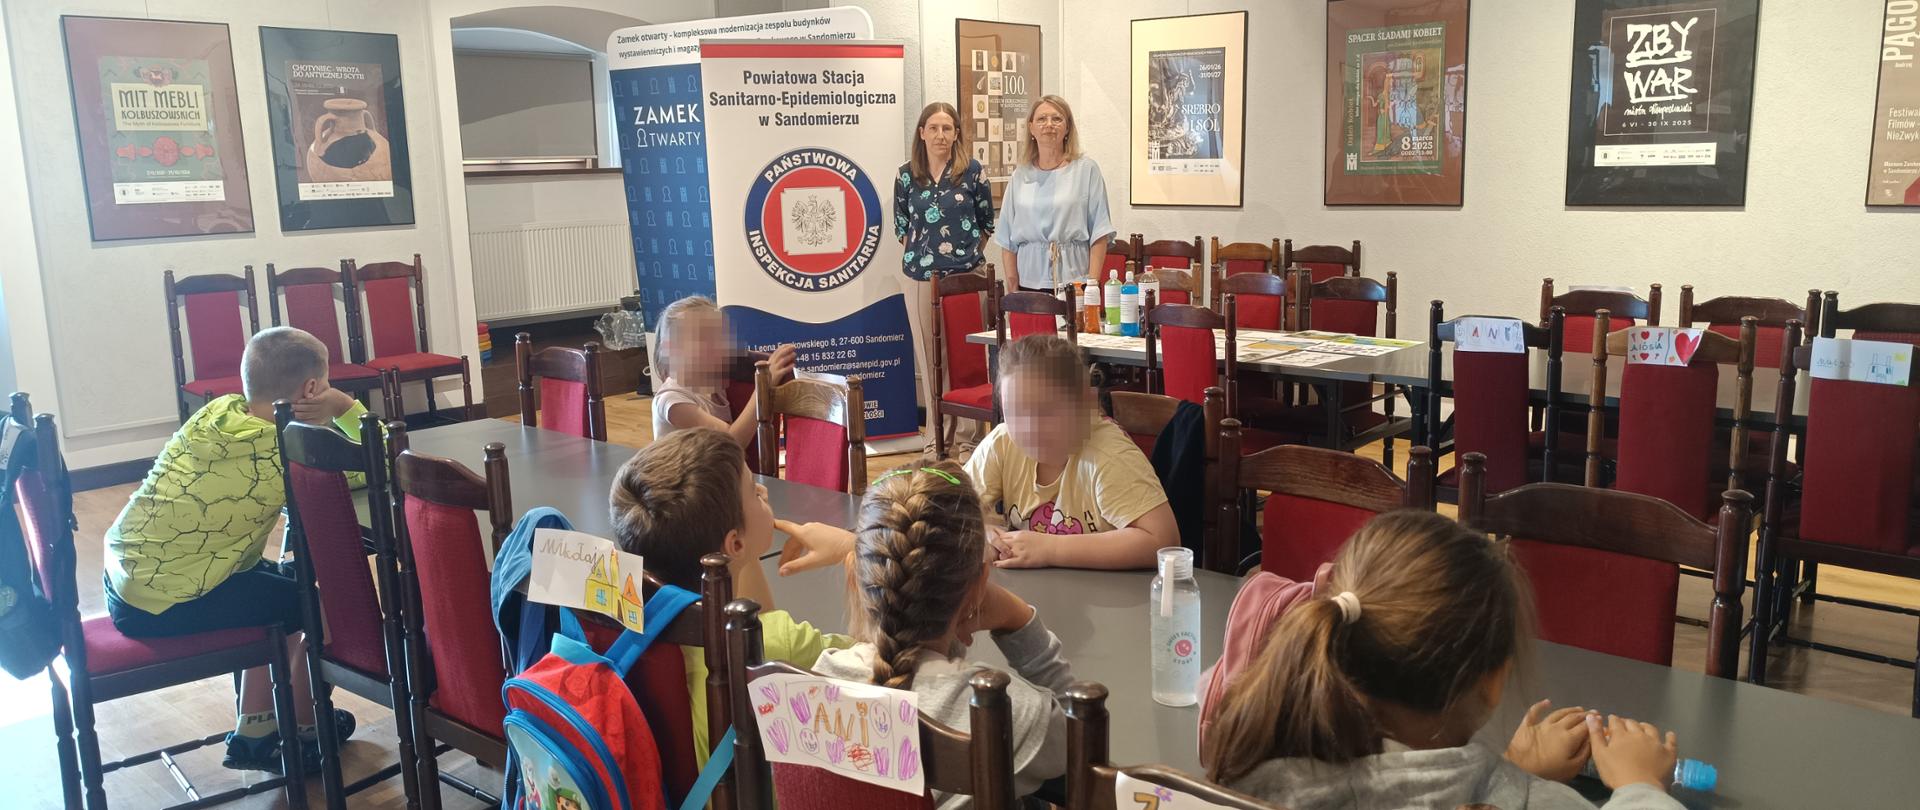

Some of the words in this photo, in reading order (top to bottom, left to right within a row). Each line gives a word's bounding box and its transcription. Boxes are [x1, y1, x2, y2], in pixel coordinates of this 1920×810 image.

[617, 33, 640, 44] Zamek
[641, 31, 668, 42] otwarty
[673, 28, 717, 38] kompleksowa
[718, 22, 764, 34] modernizacja
[792, 16, 831, 29] budynków
[1348, 33, 1376, 43] SPACER
[1413, 27, 1442, 38] KOBIET
[1626, 17, 1698, 60] ZBY
[619, 45, 672, 59] wystawienniczych
[677, 44, 700, 54] magazy
[292, 64, 332, 72] CHOTYNIEC
[305, 71, 342, 79] ANTYCZNEJ
[743, 70, 817, 85] Powiatowa
[822, 69, 865, 87] Stacja
[1624, 67, 1698, 101] WAR
[118, 89, 148, 108] MIT
[154, 90, 199, 109] MEBLI
[709, 91, 896, 108] Sanitarno-Epidemiologiczna
[121, 110, 201, 120] KOLBUSZOWSKICH
[633, 103, 701, 125] ZAMEK
[1181, 103, 1221, 115] SREBRO
[759, 115, 770, 126] w
[775, 112, 859, 126] Sandomierzu
[1196, 117, 1220, 131] SÓL
[1888, 119, 1915, 129] Filmów
[1401, 136, 1411, 151] 8
[1411, 141, 1433, 150] 2025
[764, 151, 857, 183] PAŃSTWOWA
[749, 230, 814, 289] INSPEKCJA
[819, 225, 879, 288] SANITARNA
[840, 336, 864, 346] 27-600
[865, 333, 904, 344] Sandomierz
[811, 353, 820, 361] 15
[821, 351, 835, 360] 832
[837, 350, 846, 359] 22
[847, 349, 857, 358] 63
[540, 538, 599, 573] Mikołaj
[246, 712, 276, 725] PLA
